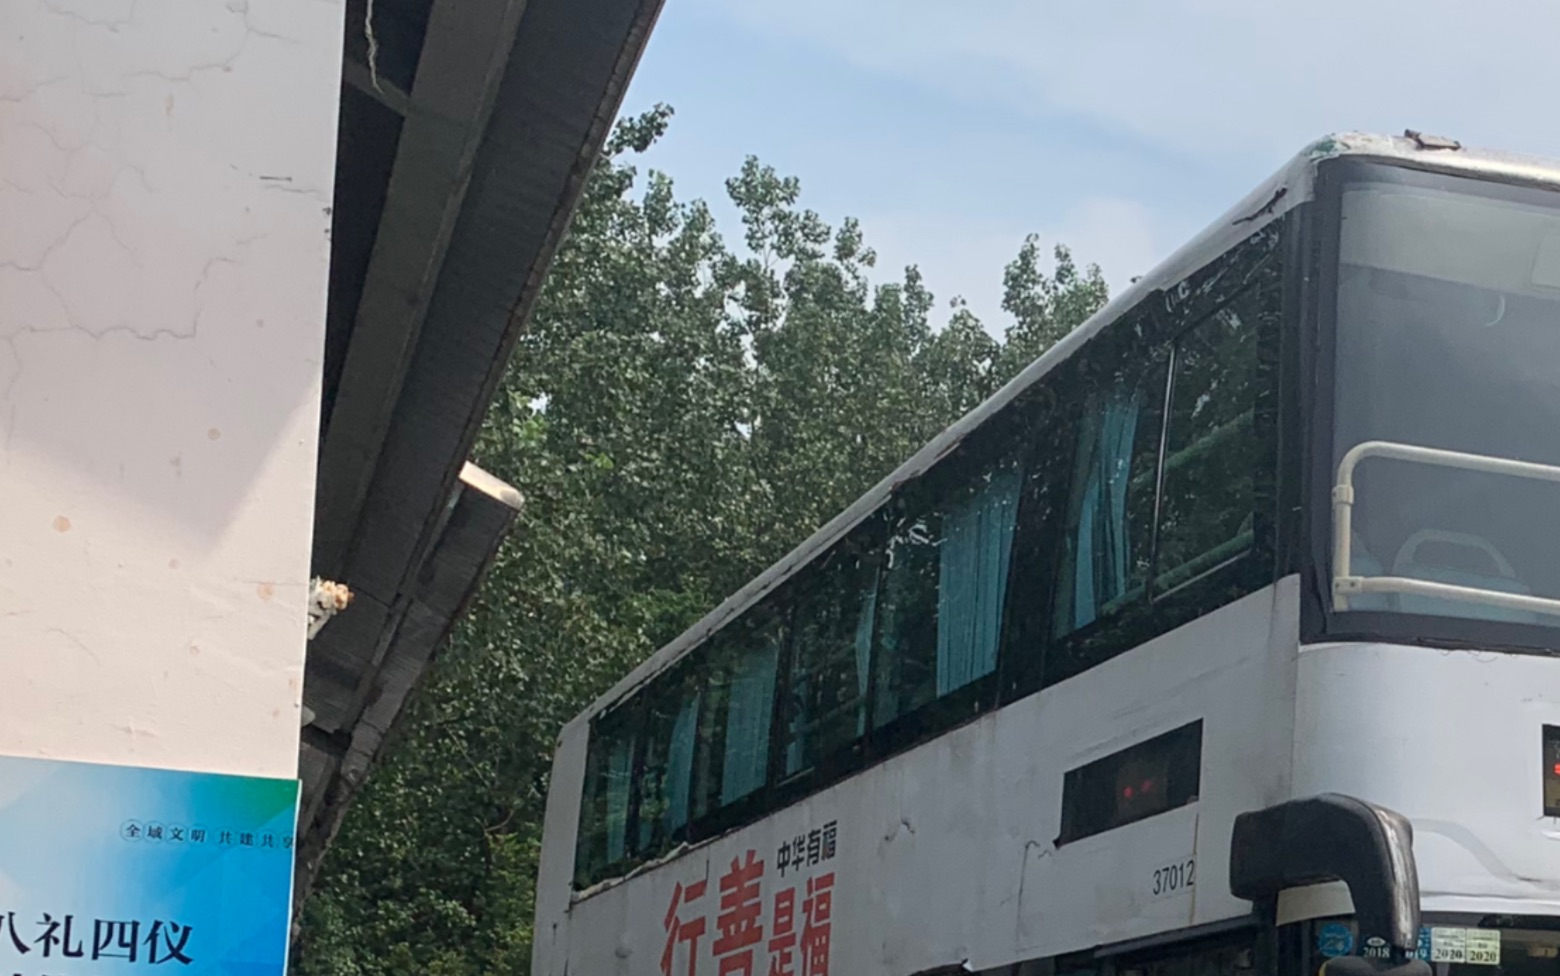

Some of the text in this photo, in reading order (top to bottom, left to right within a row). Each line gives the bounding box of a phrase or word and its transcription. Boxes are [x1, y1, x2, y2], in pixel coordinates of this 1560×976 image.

[124, 823, 206, 843] 全域文明
[776, 820, 838, 878] 中华有福
[1153, 859, 1195, 895] 37012
[1363, 947, 1391, 959] 2018
[1434, 948, 1463, 960] 2020
[1469, 951, 1498, 963] 2020
